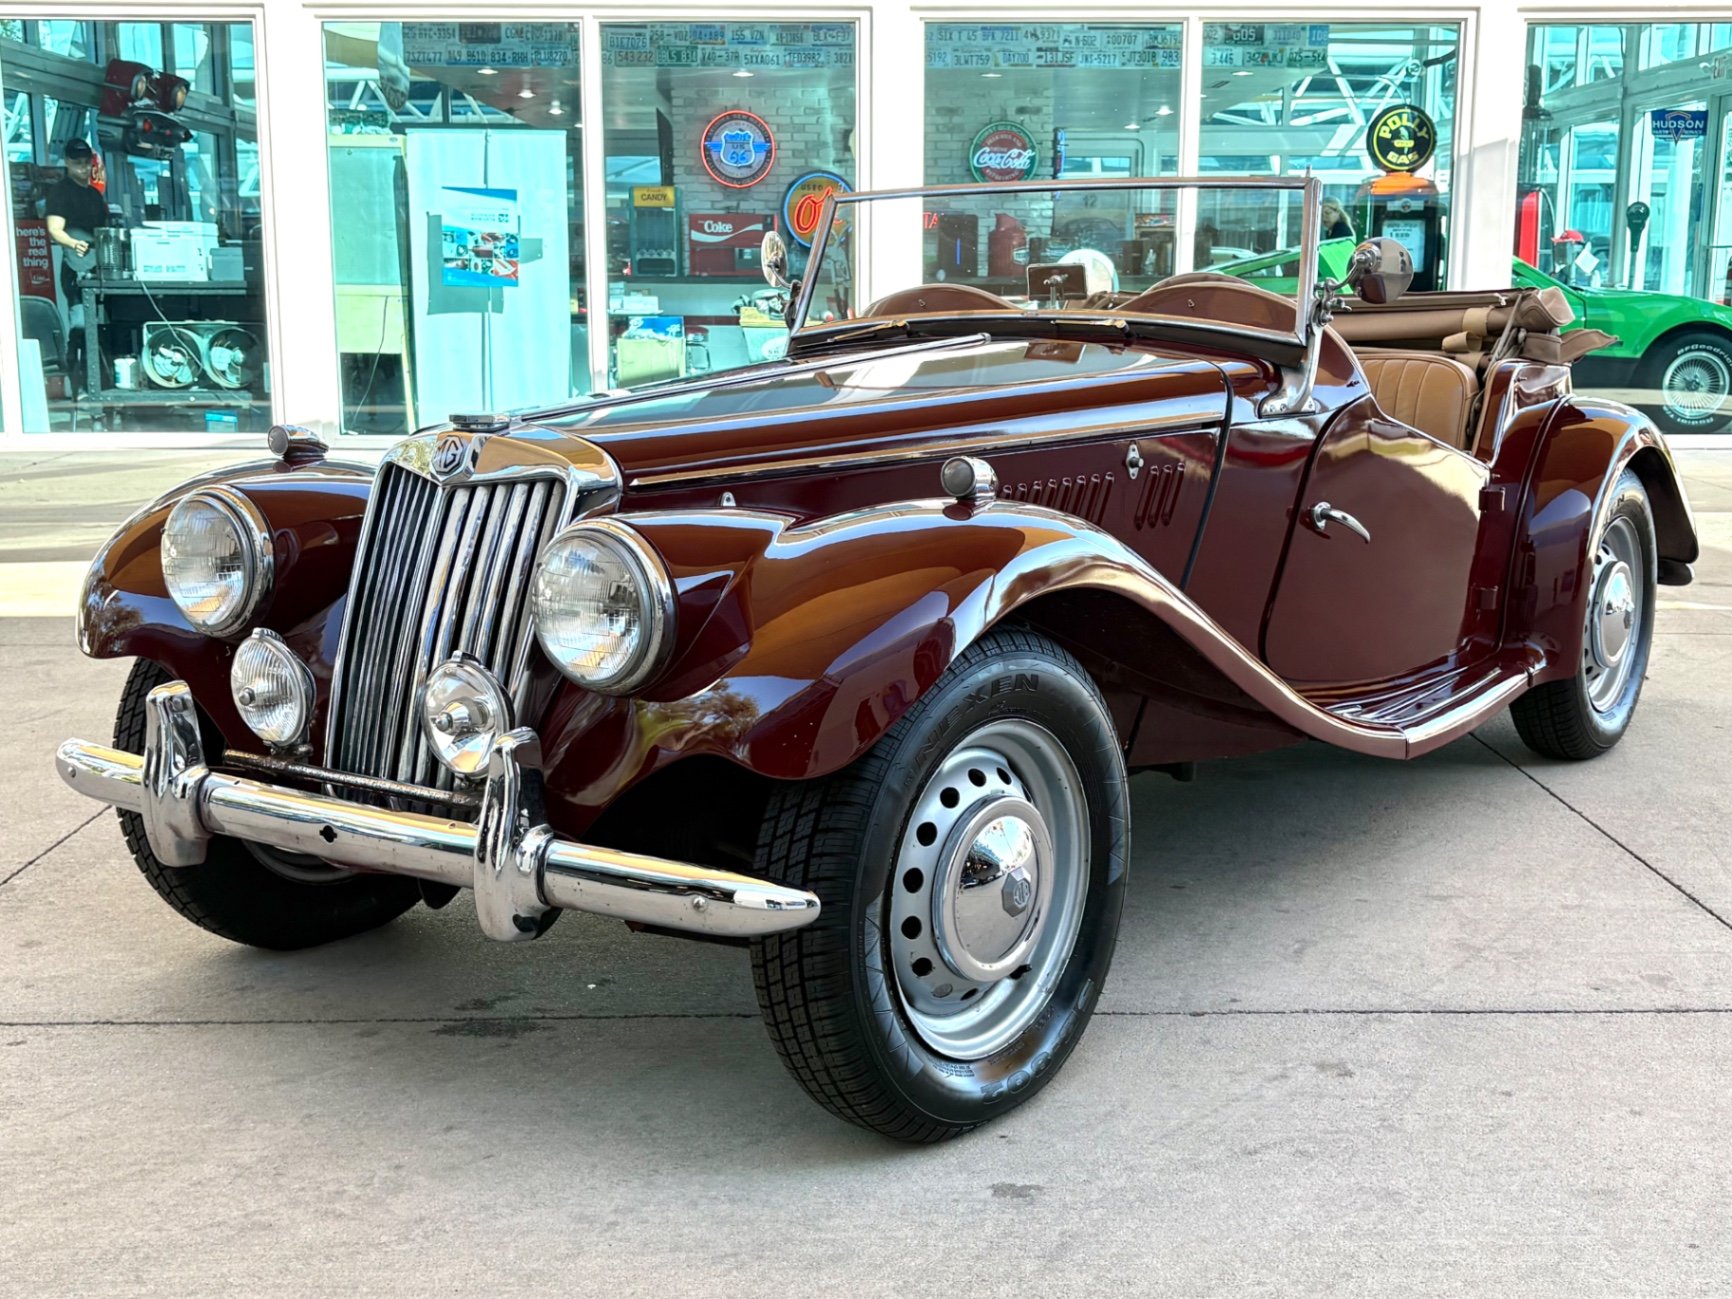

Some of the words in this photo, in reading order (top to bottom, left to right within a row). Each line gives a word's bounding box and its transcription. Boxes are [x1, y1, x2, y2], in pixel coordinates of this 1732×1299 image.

[1379, 113, 1429, 139] POLLY
[1652, 120, 1705, 129] HUDSON
[728, 150, 749, 163] 66
[1386, 151, 1419, 164] GAS
[640, 192, 668, 201] CANDY
[15, 227, 46, 237] here's
[703, 219, 734, 233] Coke
[29, 237, 46, 246] the
[28, 247, 48, 256] real
[23, 257, 49, 270] thing
[433, 437, 460, 469] MG
[914, 673, 1039, 766] NEXEN
